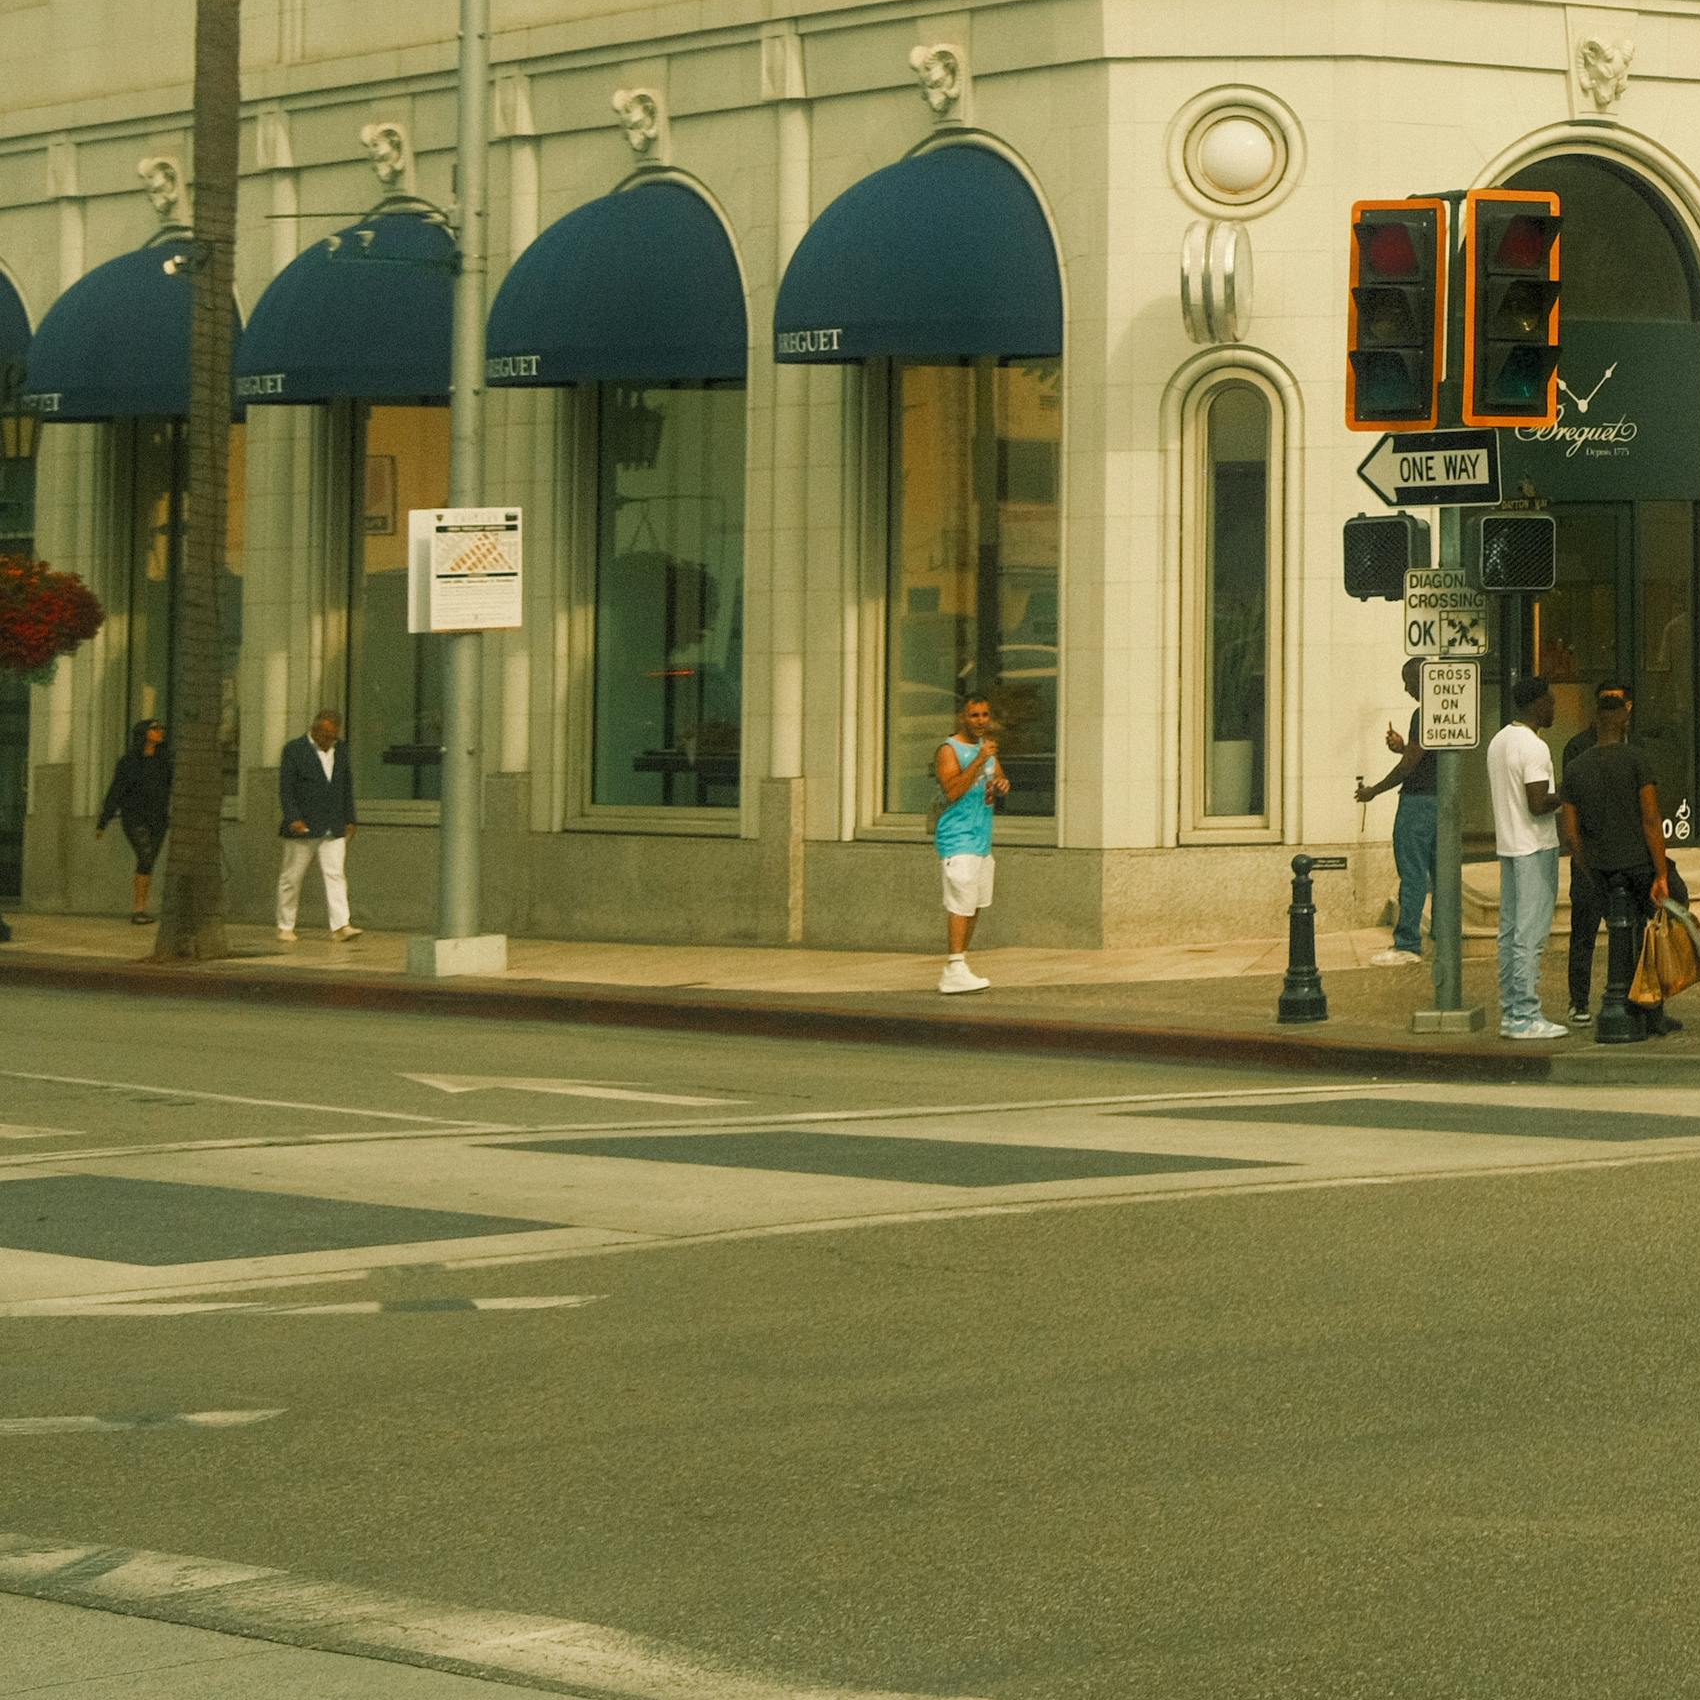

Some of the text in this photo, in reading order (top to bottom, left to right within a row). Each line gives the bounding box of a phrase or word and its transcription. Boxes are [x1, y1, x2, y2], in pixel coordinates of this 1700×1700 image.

[1400, 454, 1480, 482] ONE WAY
[1409, 573, 1465, 589] DIAGON
[1408, 592, 1485, 609] CROSSING
[1408, 620, 1436, 647] OK
[1428, 669, 1472, 681] CROSS
[1433, 684, 1467, 696] ONLY
[1441, 699, 1459, 710] ON
[1432, 713, 1467, 725] WALK
[1426, 728, 1473, 740] SIGNAL
